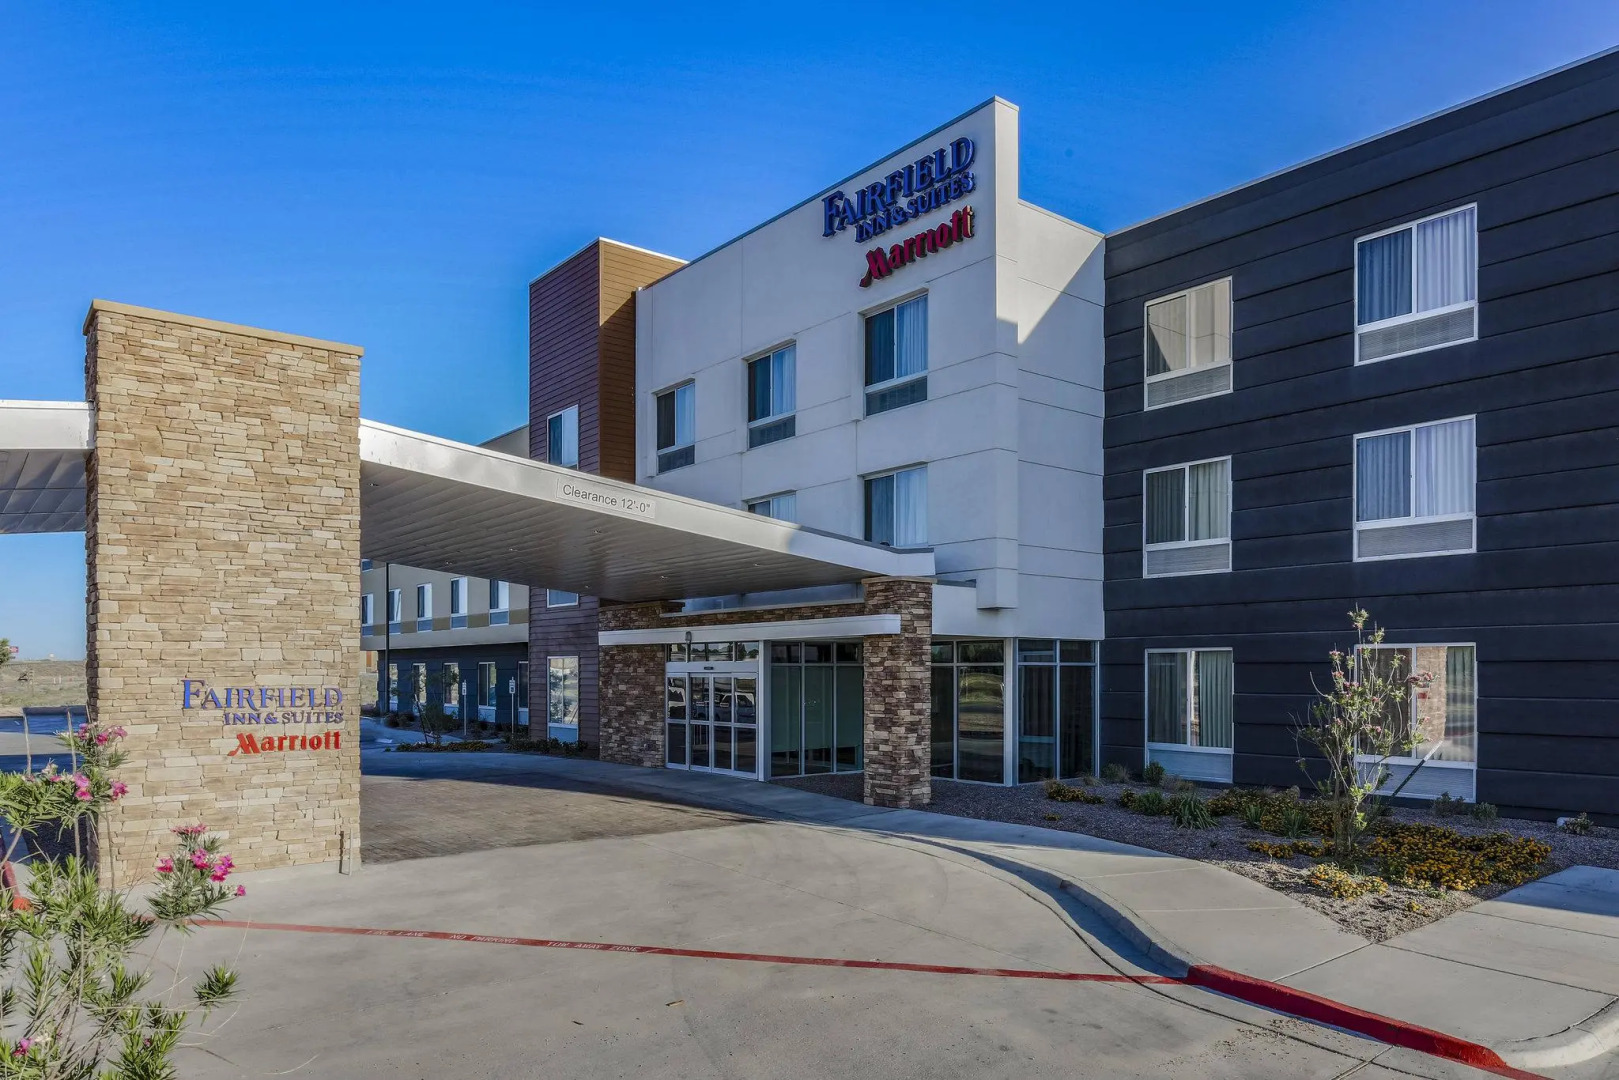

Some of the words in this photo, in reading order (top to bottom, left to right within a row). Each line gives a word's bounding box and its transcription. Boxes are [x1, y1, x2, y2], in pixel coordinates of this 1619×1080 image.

[822, 137, 975, 237] FAIRFIELD
[859, 205, 974, 287] Marriott
[563, 484, 617, 506] Clearance
[181, 679, 343, 711] FAIRFIELD
[227, 731, 341, 757] Marriott
